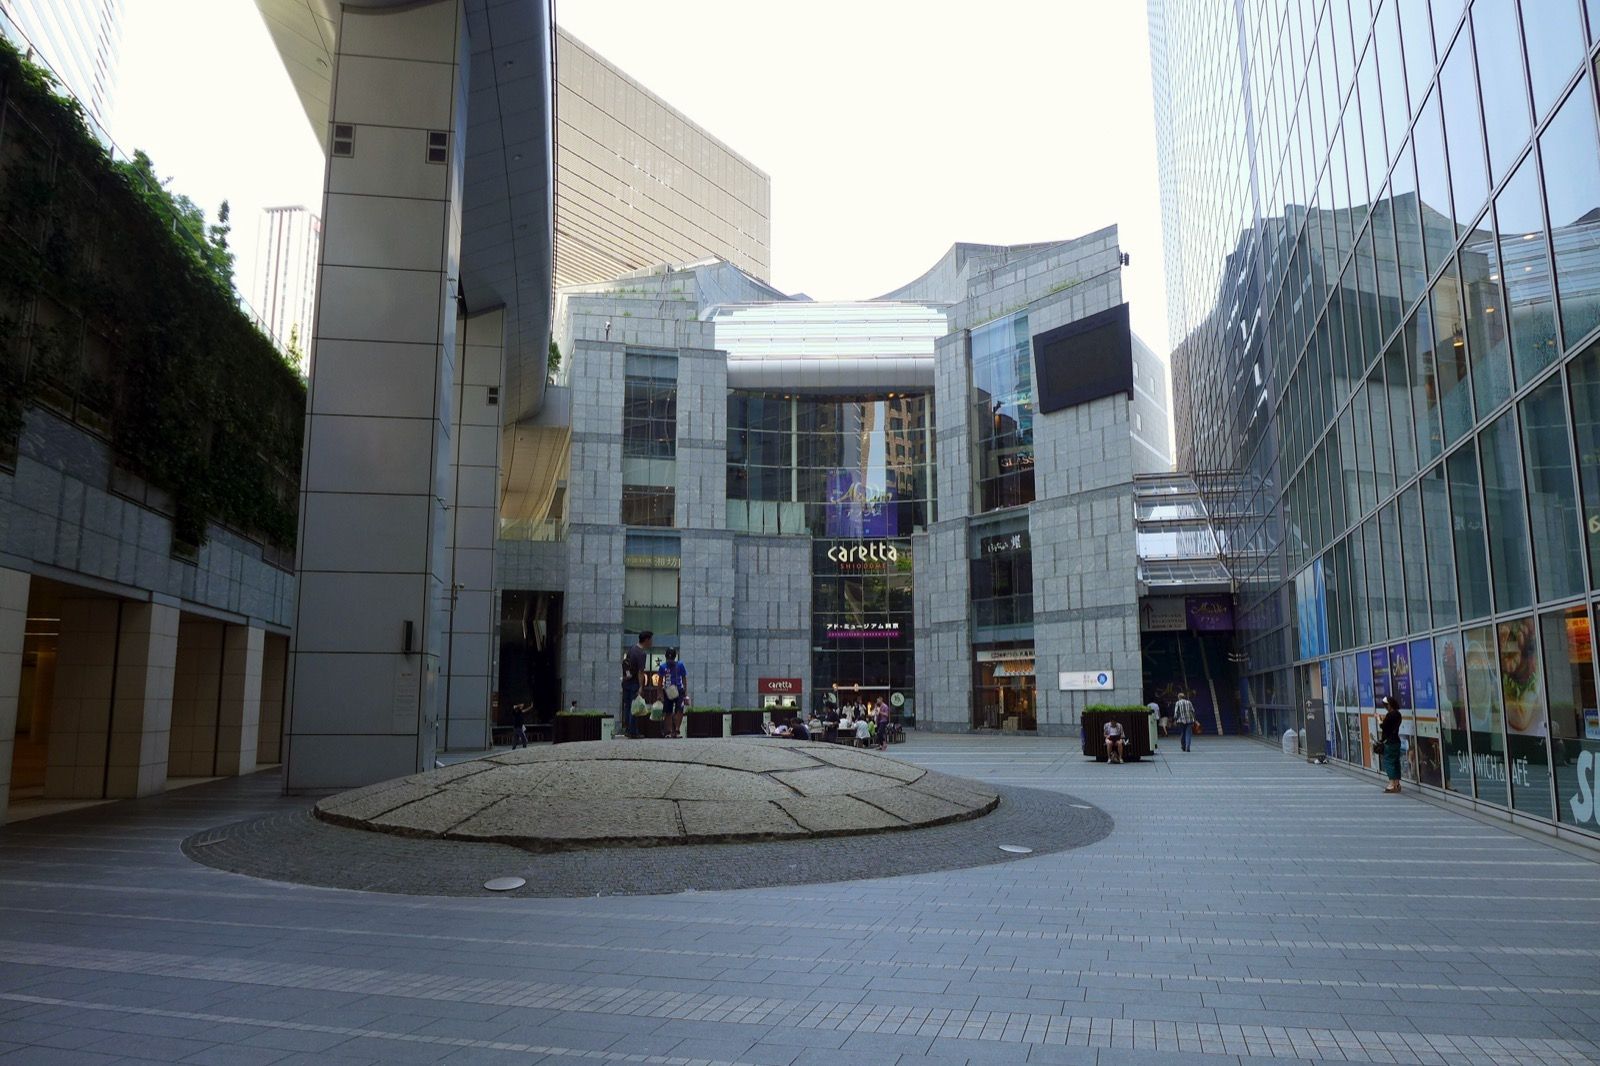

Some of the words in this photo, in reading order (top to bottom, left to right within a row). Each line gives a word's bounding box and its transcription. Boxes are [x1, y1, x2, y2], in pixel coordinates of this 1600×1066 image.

[827, 542, 897, 562] caretta
[768, 681, 792, 689] caretta
[1457, 750, 1498, 781] SANWICH
[1510, 755, 1530, 787] AFÉ
[1569, 750, 1600, 826] S
